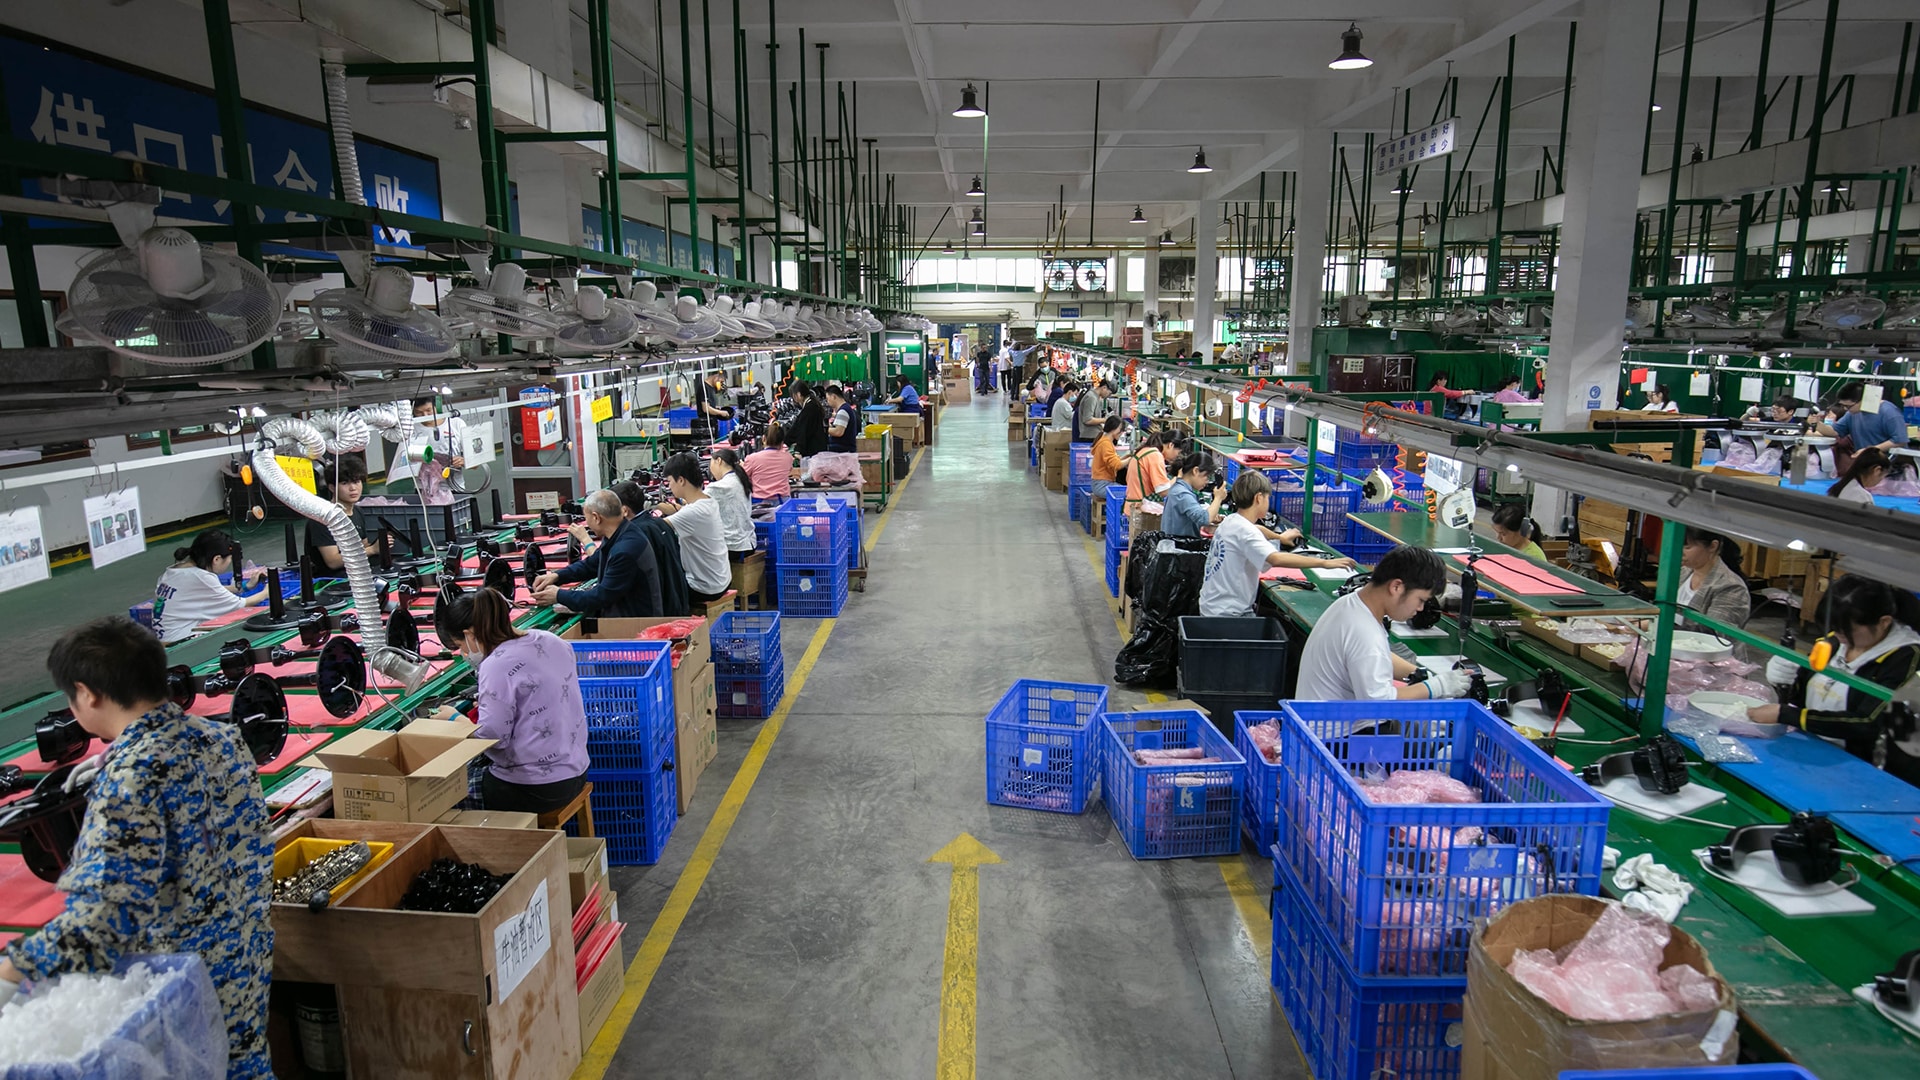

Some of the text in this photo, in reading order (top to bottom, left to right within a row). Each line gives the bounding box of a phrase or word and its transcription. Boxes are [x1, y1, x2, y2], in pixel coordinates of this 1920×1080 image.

[1381, 123, 1449, 157] 整理整顿做的好
[1379, 139, 1448, 171] 品质问题会减少
[507, 661, 526, 677] GIRL
[528, 705, 548, 716] GIRL
[538, 752, 559, 763] GIRL
